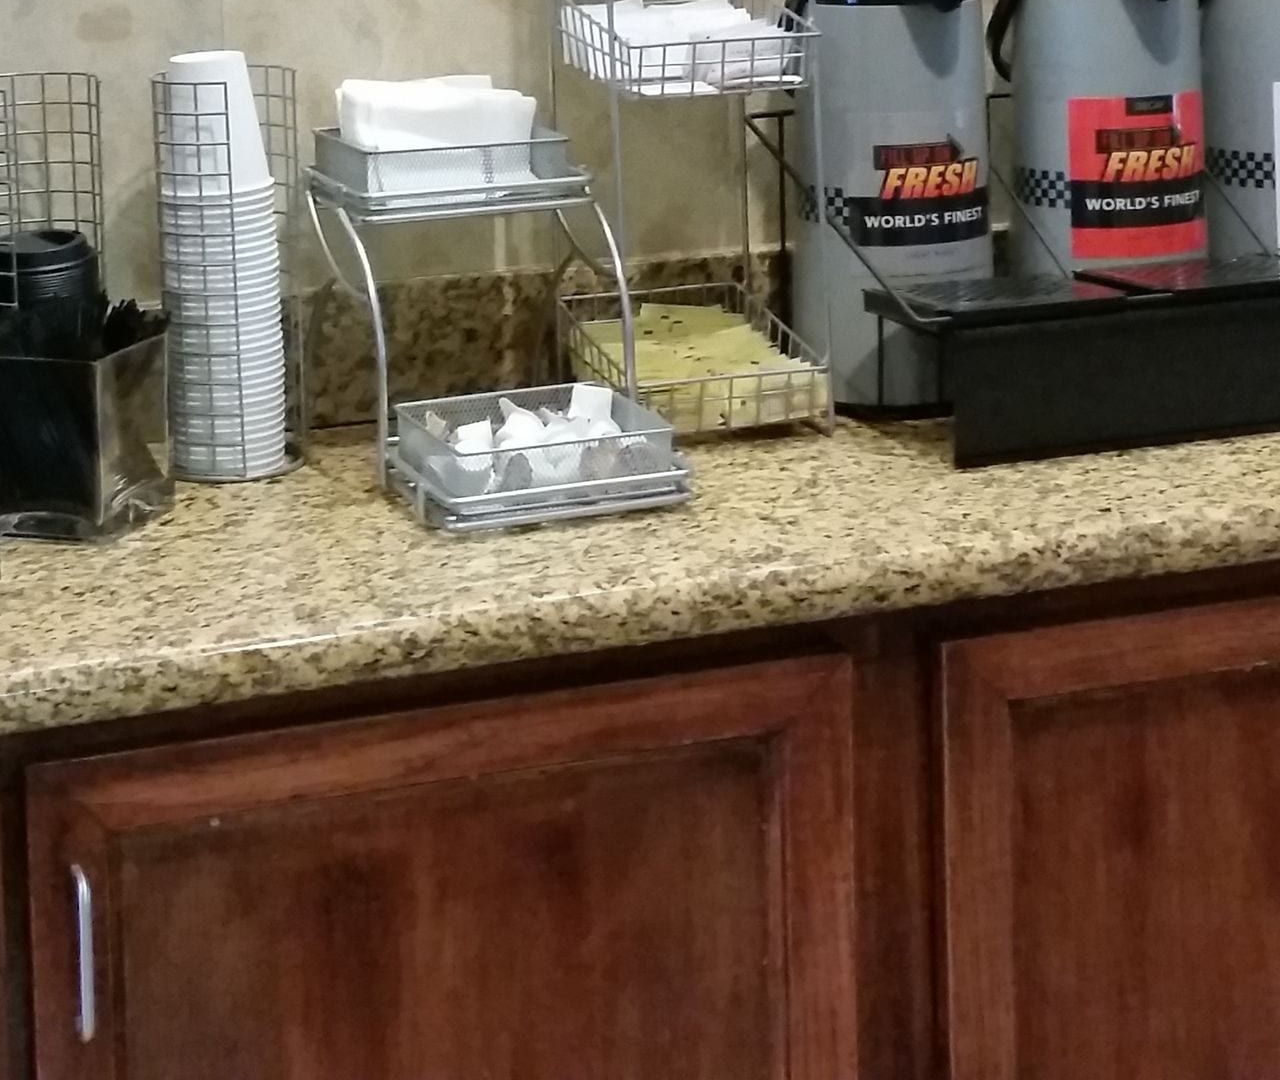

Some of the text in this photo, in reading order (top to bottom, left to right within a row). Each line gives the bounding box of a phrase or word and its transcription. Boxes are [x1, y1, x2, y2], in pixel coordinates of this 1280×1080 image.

[1102, 144, 1195, 182] FRESH
[881, 159, 978, 200] FRESH
[1085, 189, 1200, 211] WORLD'S FINEST
[864, 206, 983, 228] WORLD'S FINEST
